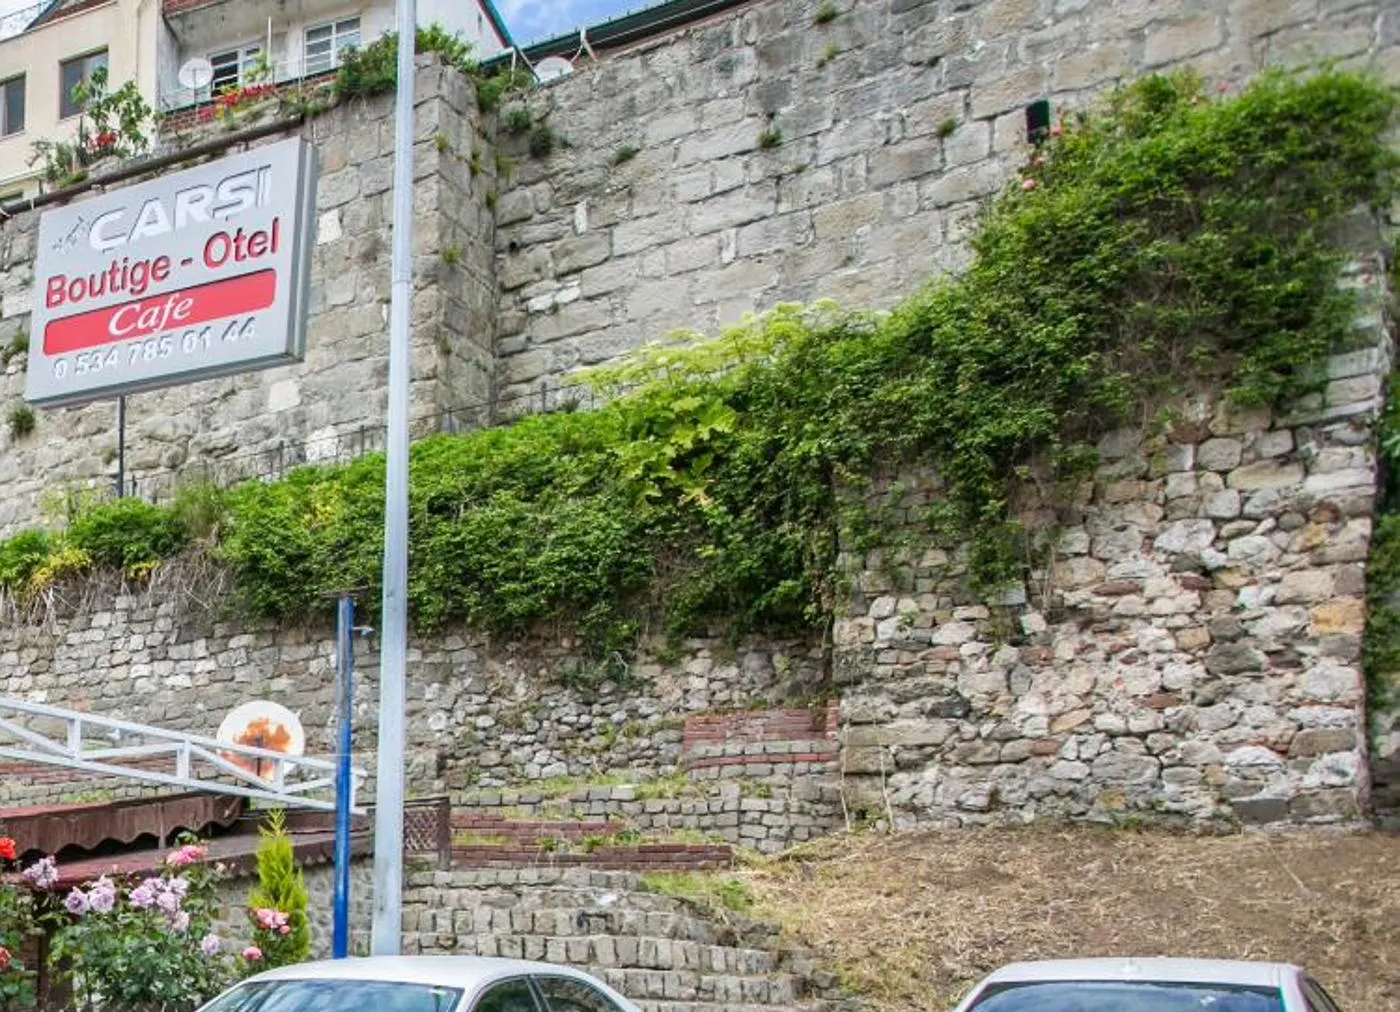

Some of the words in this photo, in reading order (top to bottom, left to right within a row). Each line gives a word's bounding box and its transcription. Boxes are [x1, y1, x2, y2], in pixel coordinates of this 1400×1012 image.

[46, 255, 170, 309] Boutige
[203, 216, 280, 269] Otel
[108, 291, 194, 337] Cafe
[54, 358, 69, 380] 0
[75, 347, 118, 375] 534
[127, 335, 174, 367] 785
[182, 326, 212, 354] 01
[222, 316, 256, 342] 44
